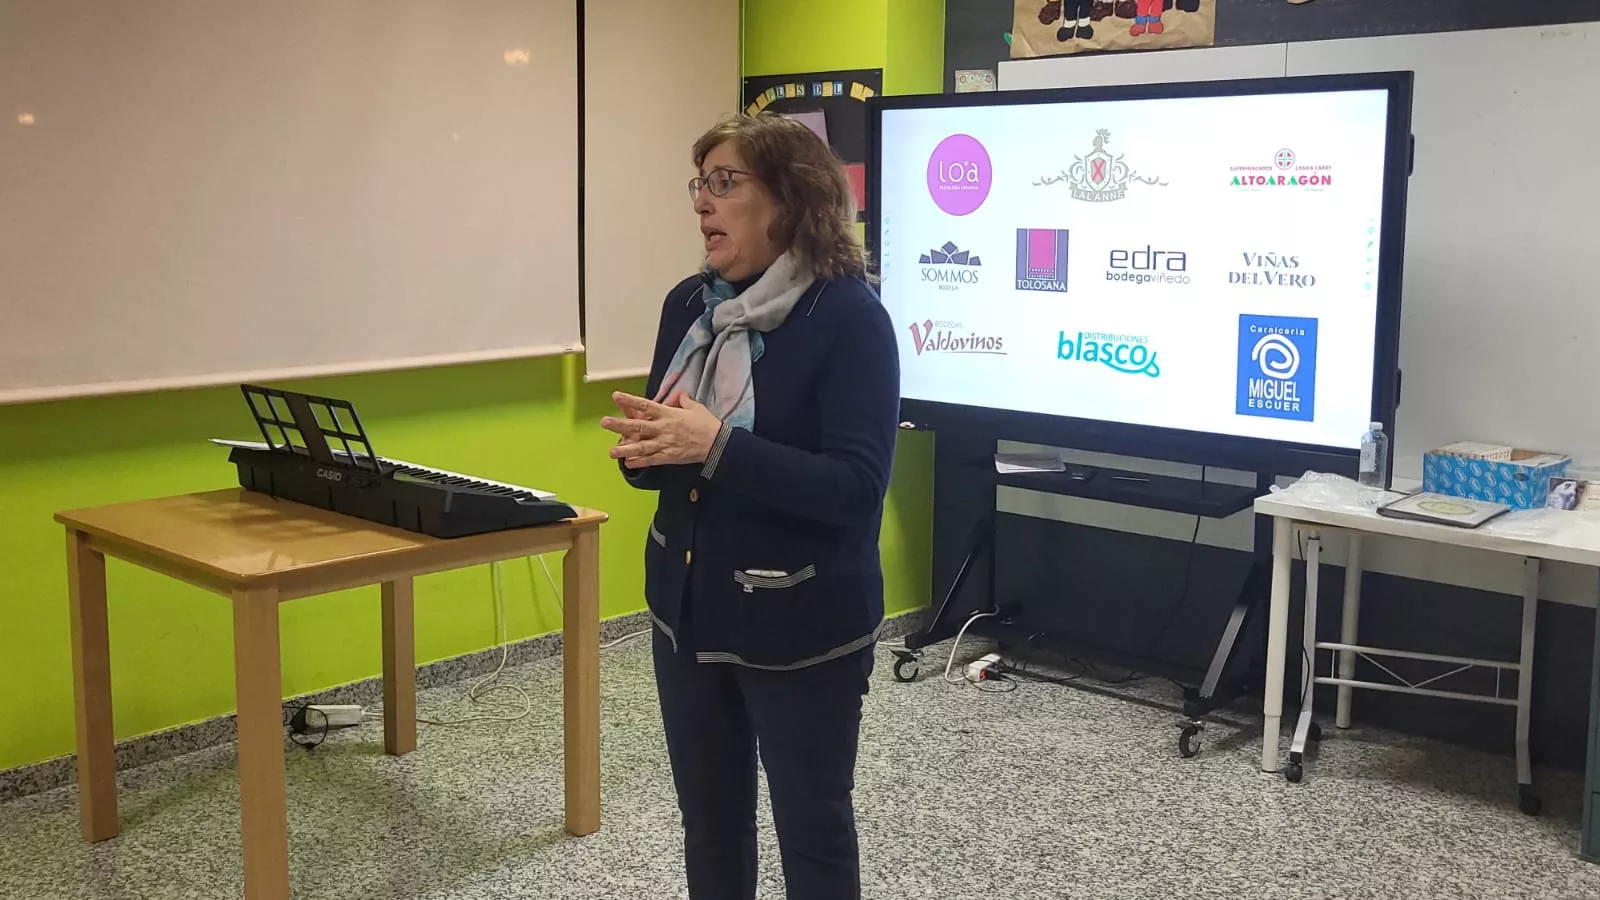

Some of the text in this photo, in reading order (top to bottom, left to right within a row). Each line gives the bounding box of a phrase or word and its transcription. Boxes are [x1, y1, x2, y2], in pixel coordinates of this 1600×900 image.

[1230, 171, 1332, 186] ALTOARAGÓN
[1110, 244, 1187, 272] edra
[1242, 251, 1300, 269] VIÑAS
[920, 268, 979, 284] SOMMOS
[1016, 279, 1067, 292] TOLOSANA
[908, 319, 1004, 356] Valdovinos
[1057, 330, 1148, 366] blasco
[1248, 378, 1301, 403] MIGUEL
[1248, 398, 1300, 413] ESCUER
[316, 468, 342, 481] CASIO
